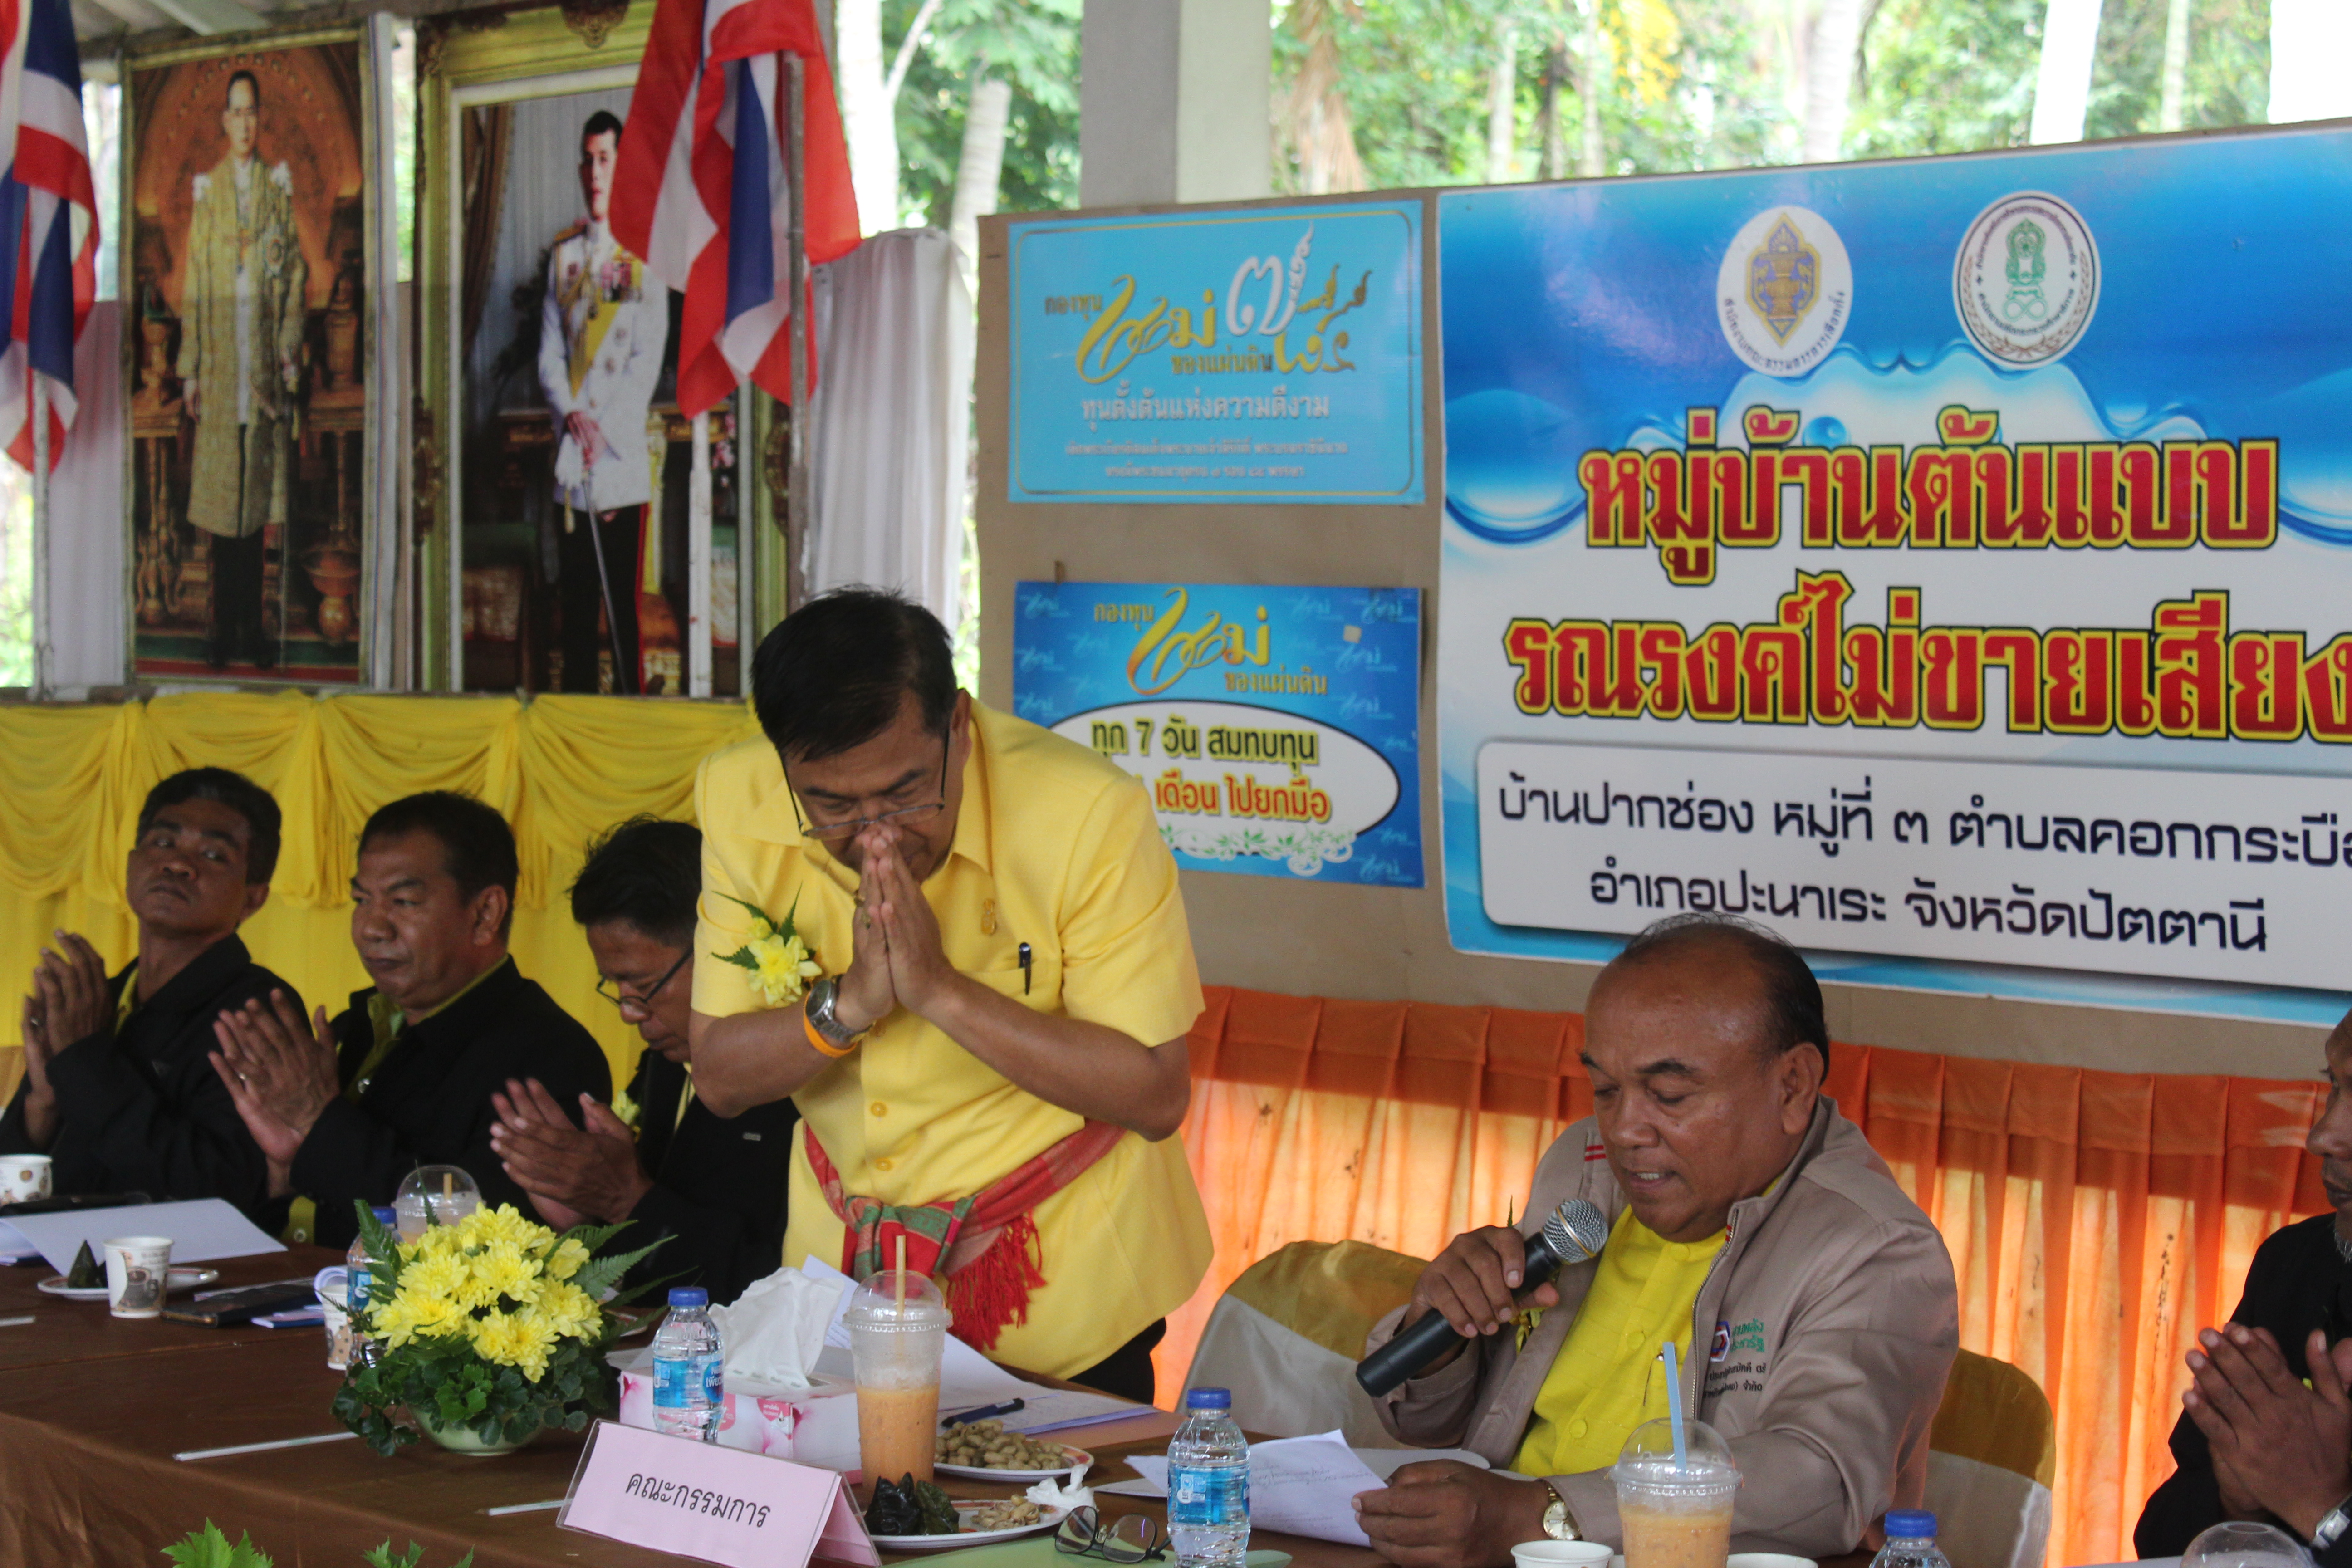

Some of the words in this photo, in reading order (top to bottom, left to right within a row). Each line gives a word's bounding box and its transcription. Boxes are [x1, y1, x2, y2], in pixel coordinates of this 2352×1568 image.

[1080, 379, 1330, 431] ทุนตั้งต้นแห่งความดีงาม
[1578, 405, 2280, 585] หมู่บ้านต้นแบบ
[1094, 603, 1154, 632] กองทุน
[1224, 666, 1328, 696] ของแผ่นดิน
[1503, 570, 2352, 743] รณรงค์ไม่ขายเสียง
[1136, 720, 1153, 755] 7
[1163, 714, 1197, 758] วัน
[1207, 725, 1319, 774] สมทบทุน
[1155, 769, 1220, 815] เดือน
[1224, 775, 1331, 823] ไปยกมือ
[1499, 773, 1753, 833] บ้านปากช่อง
[1774, 777, 1872, 857] หมู่ที่
[1893, 810, 1929, 844] ๓
[1591, 856, 1886, 922] อำเภอปะนาเระ
[1906, 878, 2267, 952] จังหวัดปัตตานี
[626, 1473, 771, 1528] คณะกรรมการ
